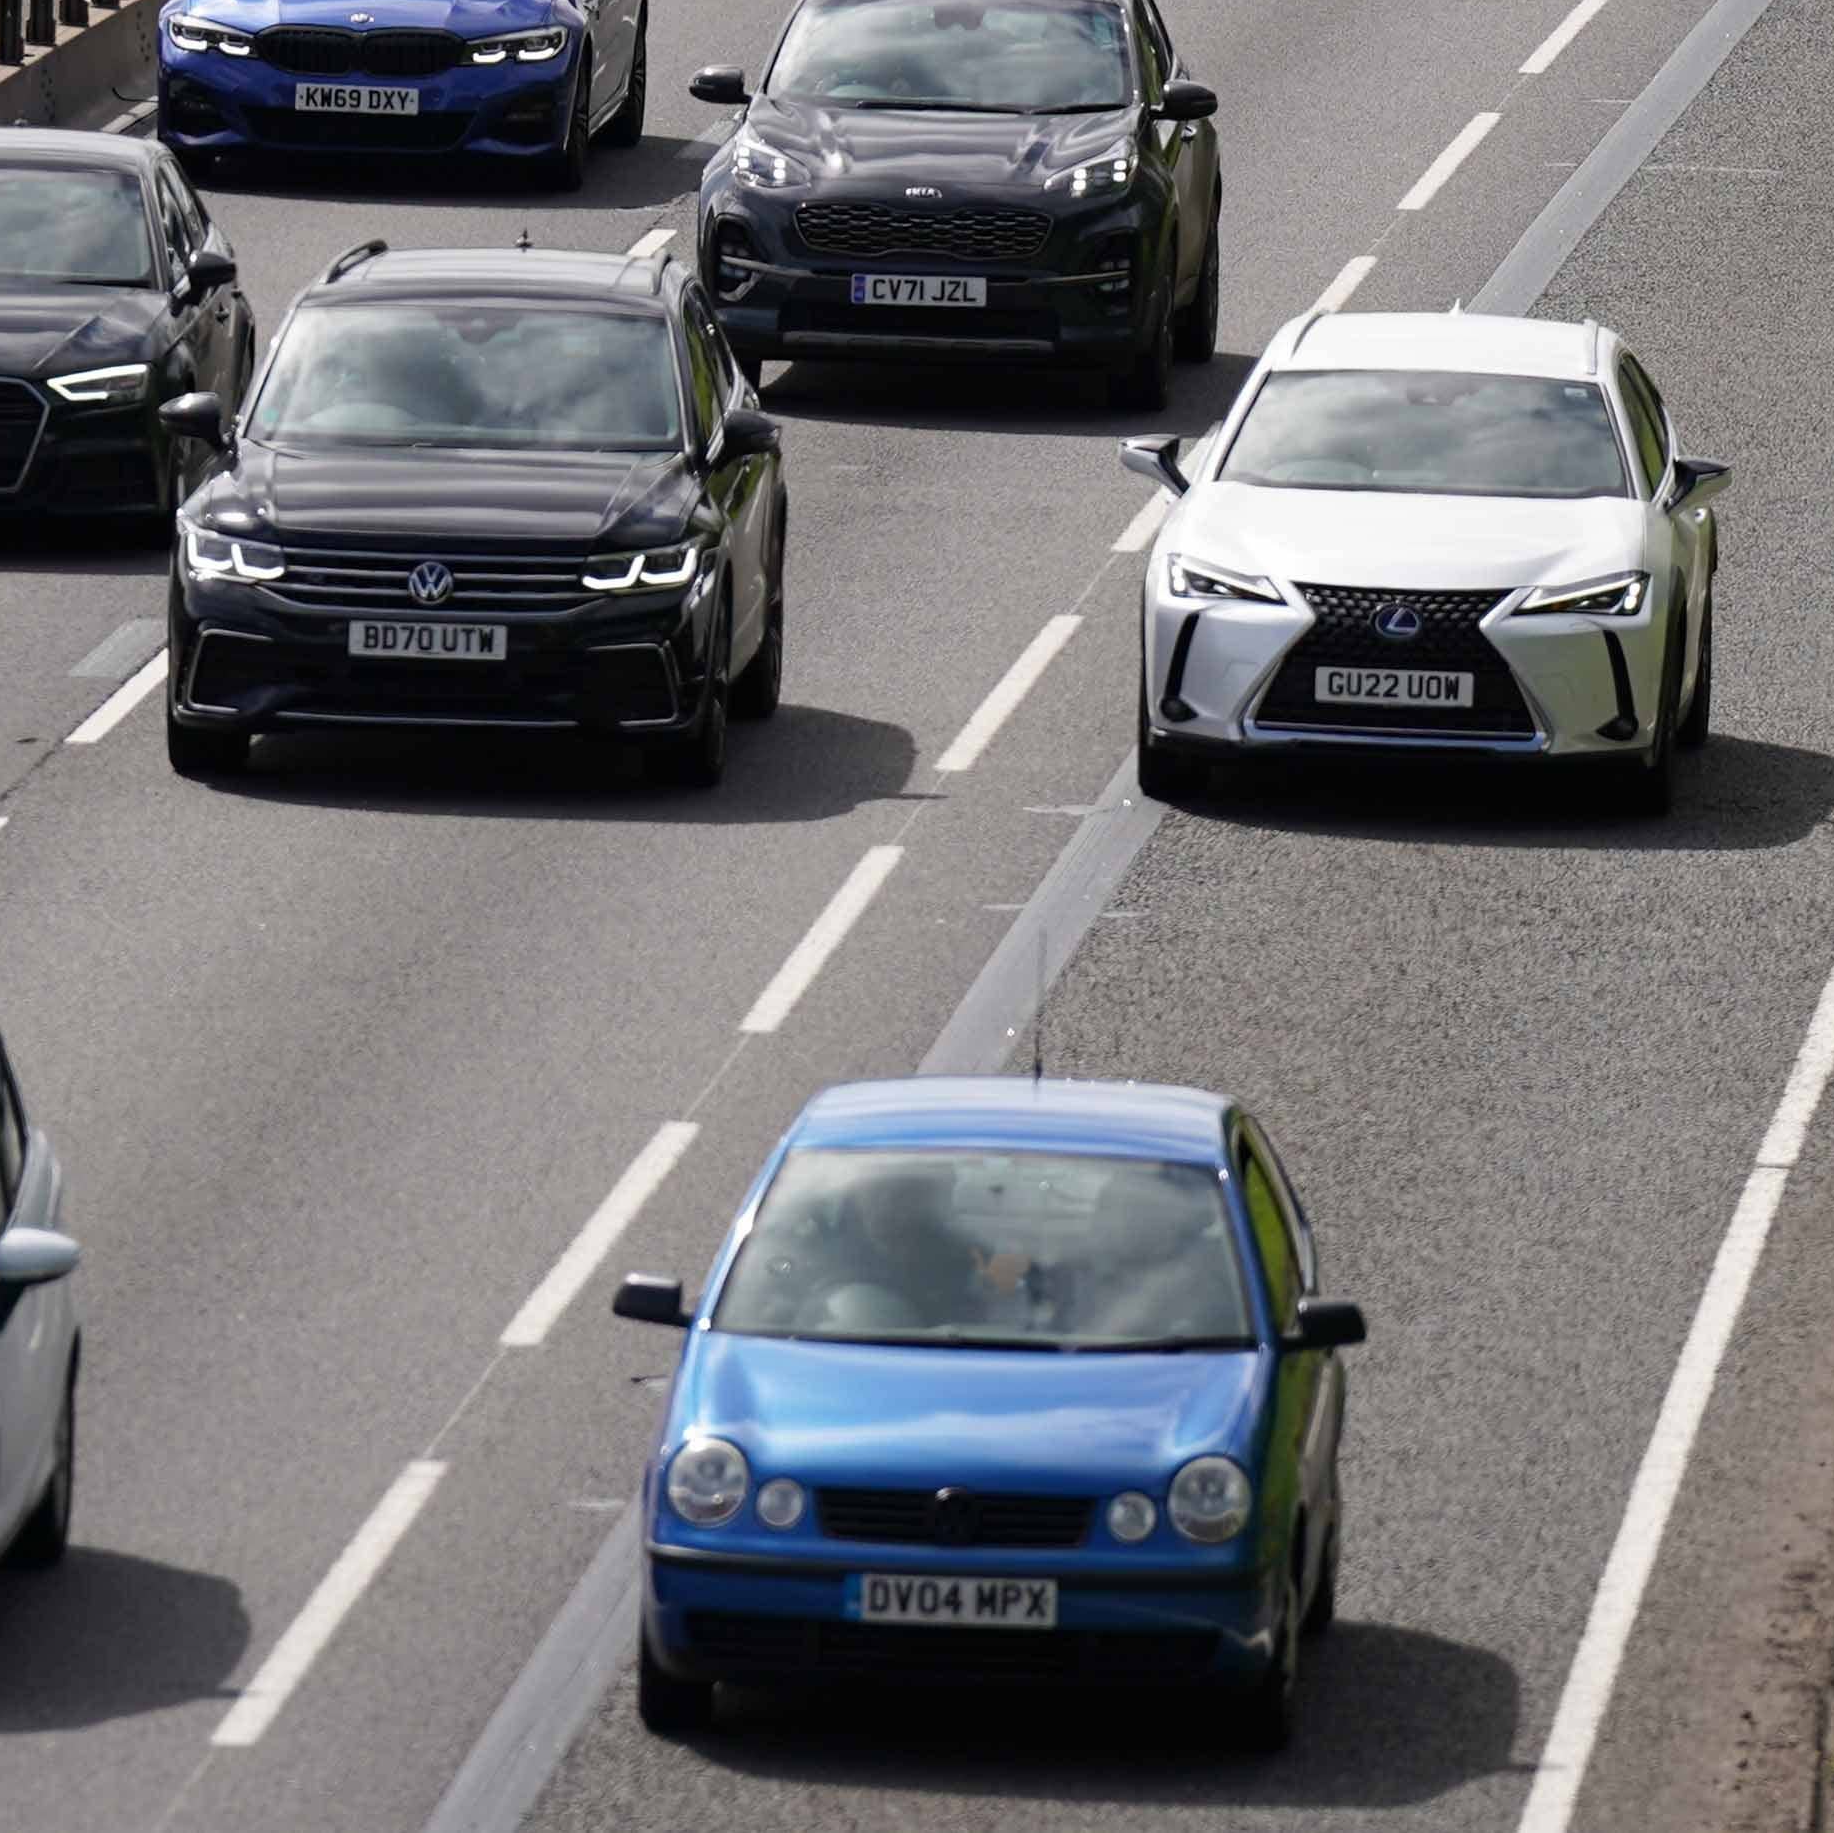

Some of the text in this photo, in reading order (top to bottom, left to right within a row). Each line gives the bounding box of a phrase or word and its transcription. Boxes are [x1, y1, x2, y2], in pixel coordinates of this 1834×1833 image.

[303, 86, 410, 112] KW69 DXY
[871, 279, 977, 304] CV71 JZL
[362, 625, 496, 653] BD70 UTW
[1326, 671, 1461, 700] GU22 UOW
[868, 1579, 1049, 1620] DV04 MPX
